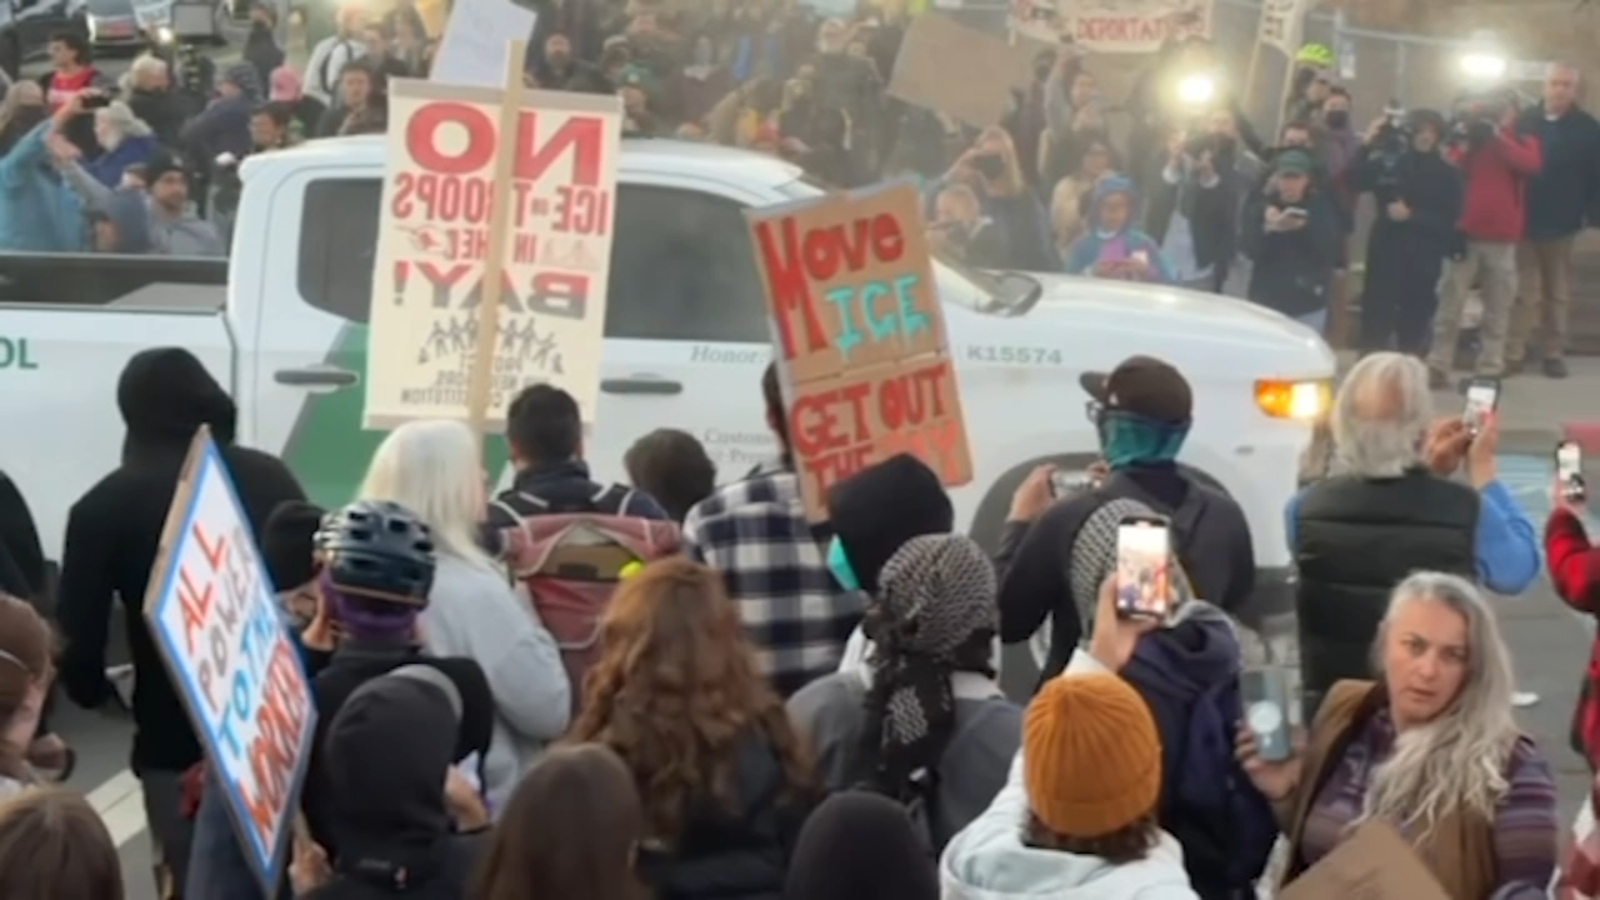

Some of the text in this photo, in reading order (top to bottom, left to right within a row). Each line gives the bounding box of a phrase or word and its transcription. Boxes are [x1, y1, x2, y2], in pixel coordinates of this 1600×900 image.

[826, 275, 930, 350] ICE
[967, 346, 1062, 364] K15574
[791, 363, 948, 458] GET OUT
[177, 521, 228, 657] ALL
[217, 668, 251, 761] TO
